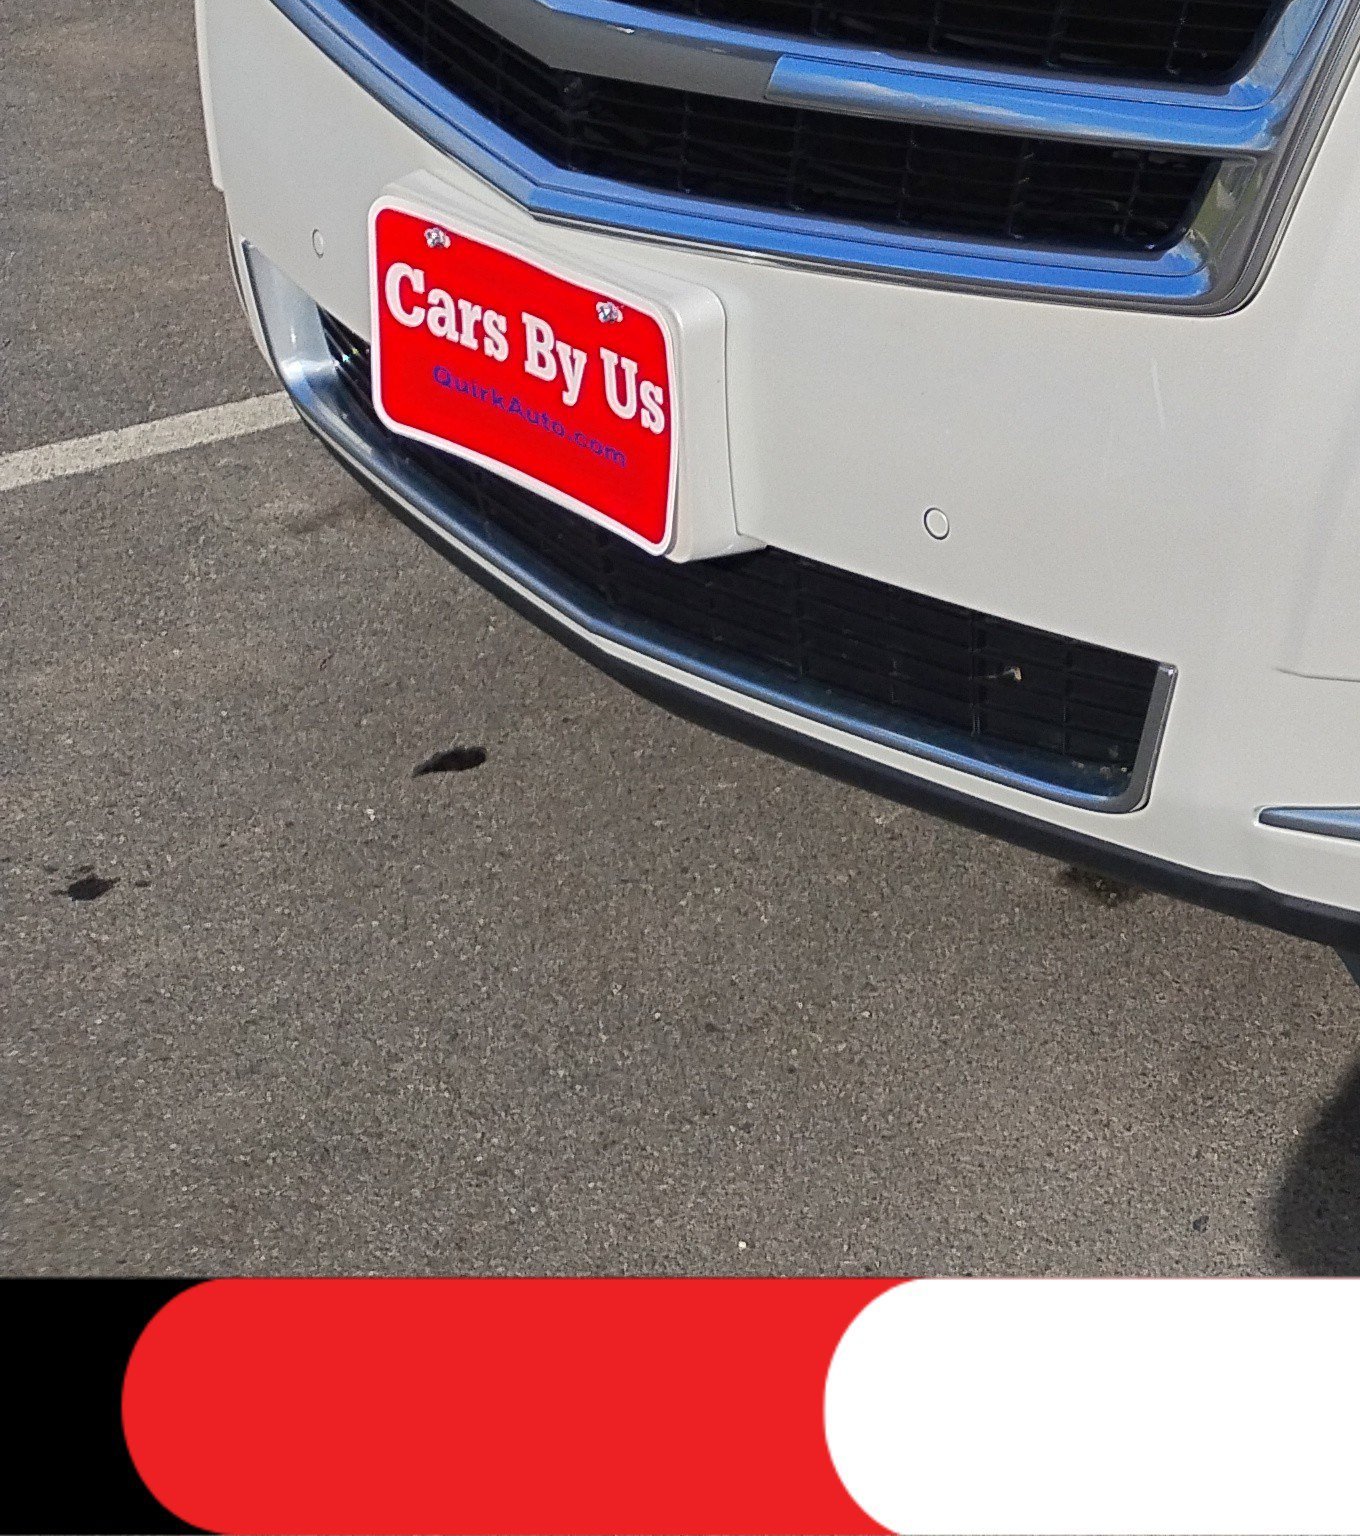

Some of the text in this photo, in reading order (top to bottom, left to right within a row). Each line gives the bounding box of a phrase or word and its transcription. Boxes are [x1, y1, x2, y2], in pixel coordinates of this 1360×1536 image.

[384, 262, 666, 435] Cars By Us
[432, 365, 628, 468] QuirkAuto.com
